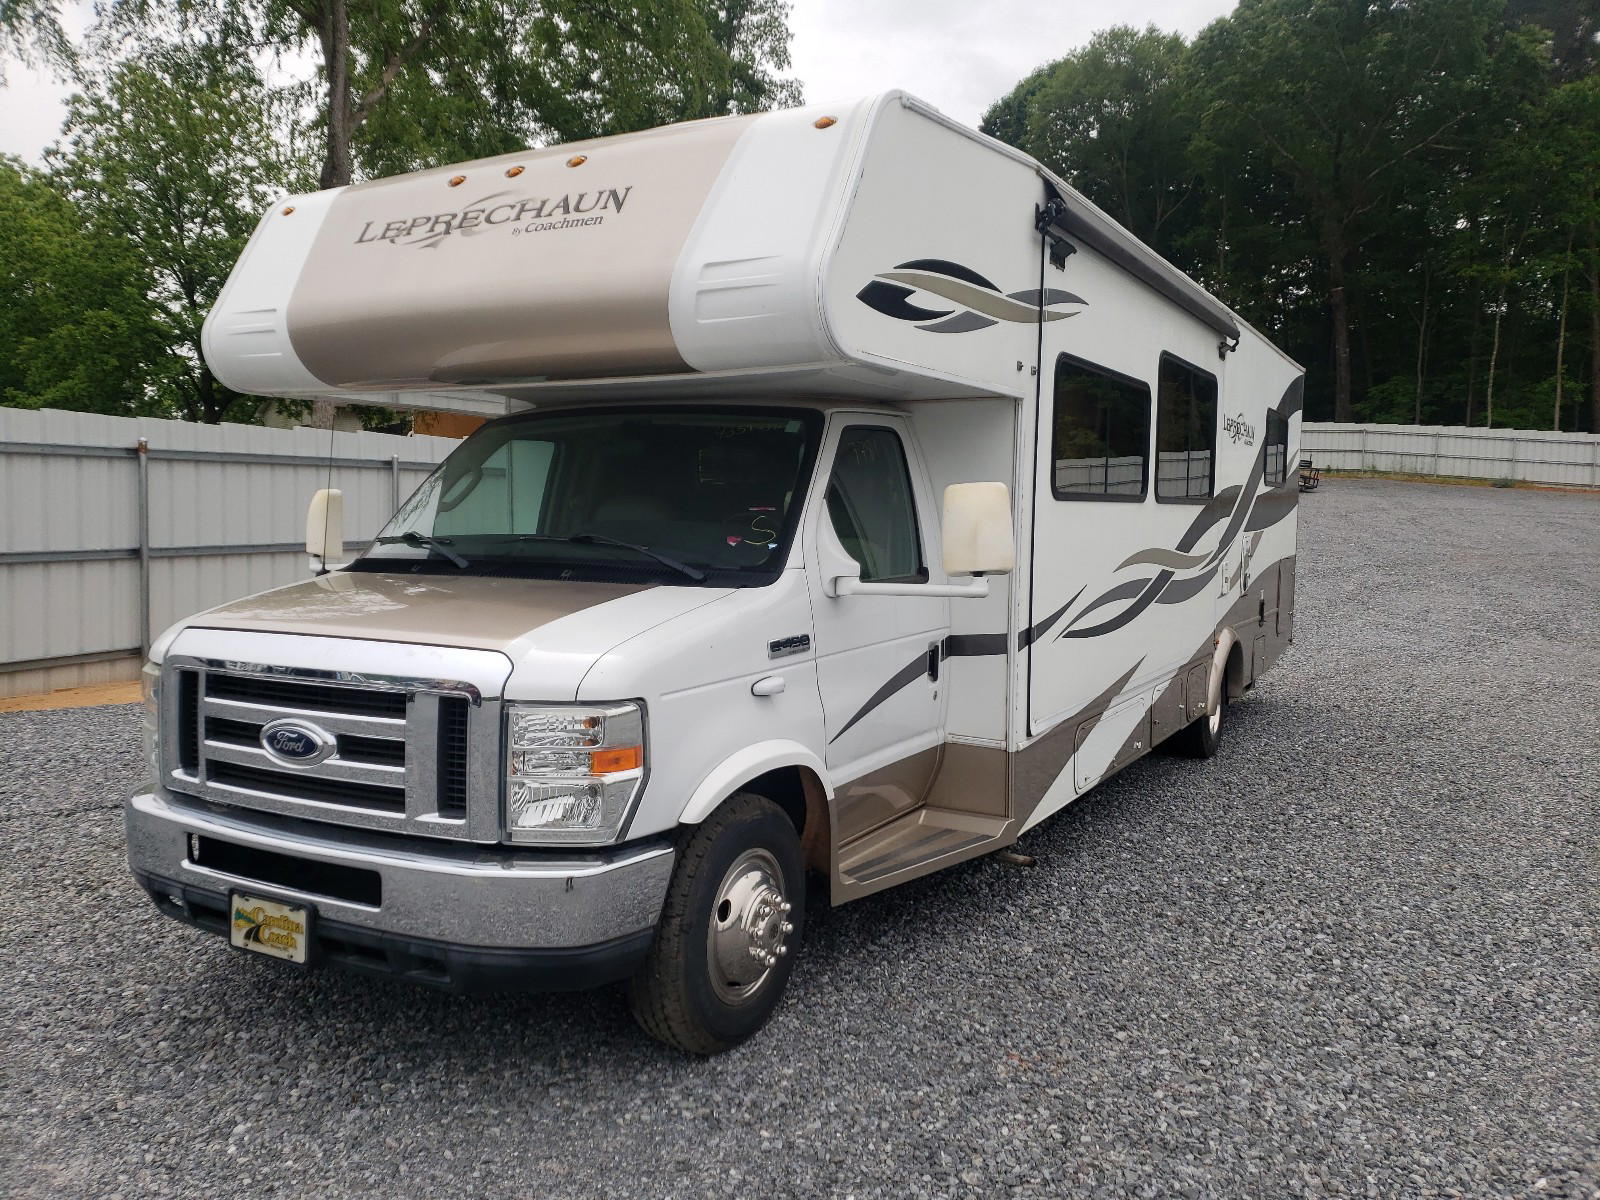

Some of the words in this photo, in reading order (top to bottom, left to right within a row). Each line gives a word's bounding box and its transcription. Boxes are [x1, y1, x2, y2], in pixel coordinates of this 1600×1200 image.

[354, 186, 633, 244] LEPRECHAUN
[524, 215, 604, 234] Coachmen
[273, 731, 305, 753] Ford
